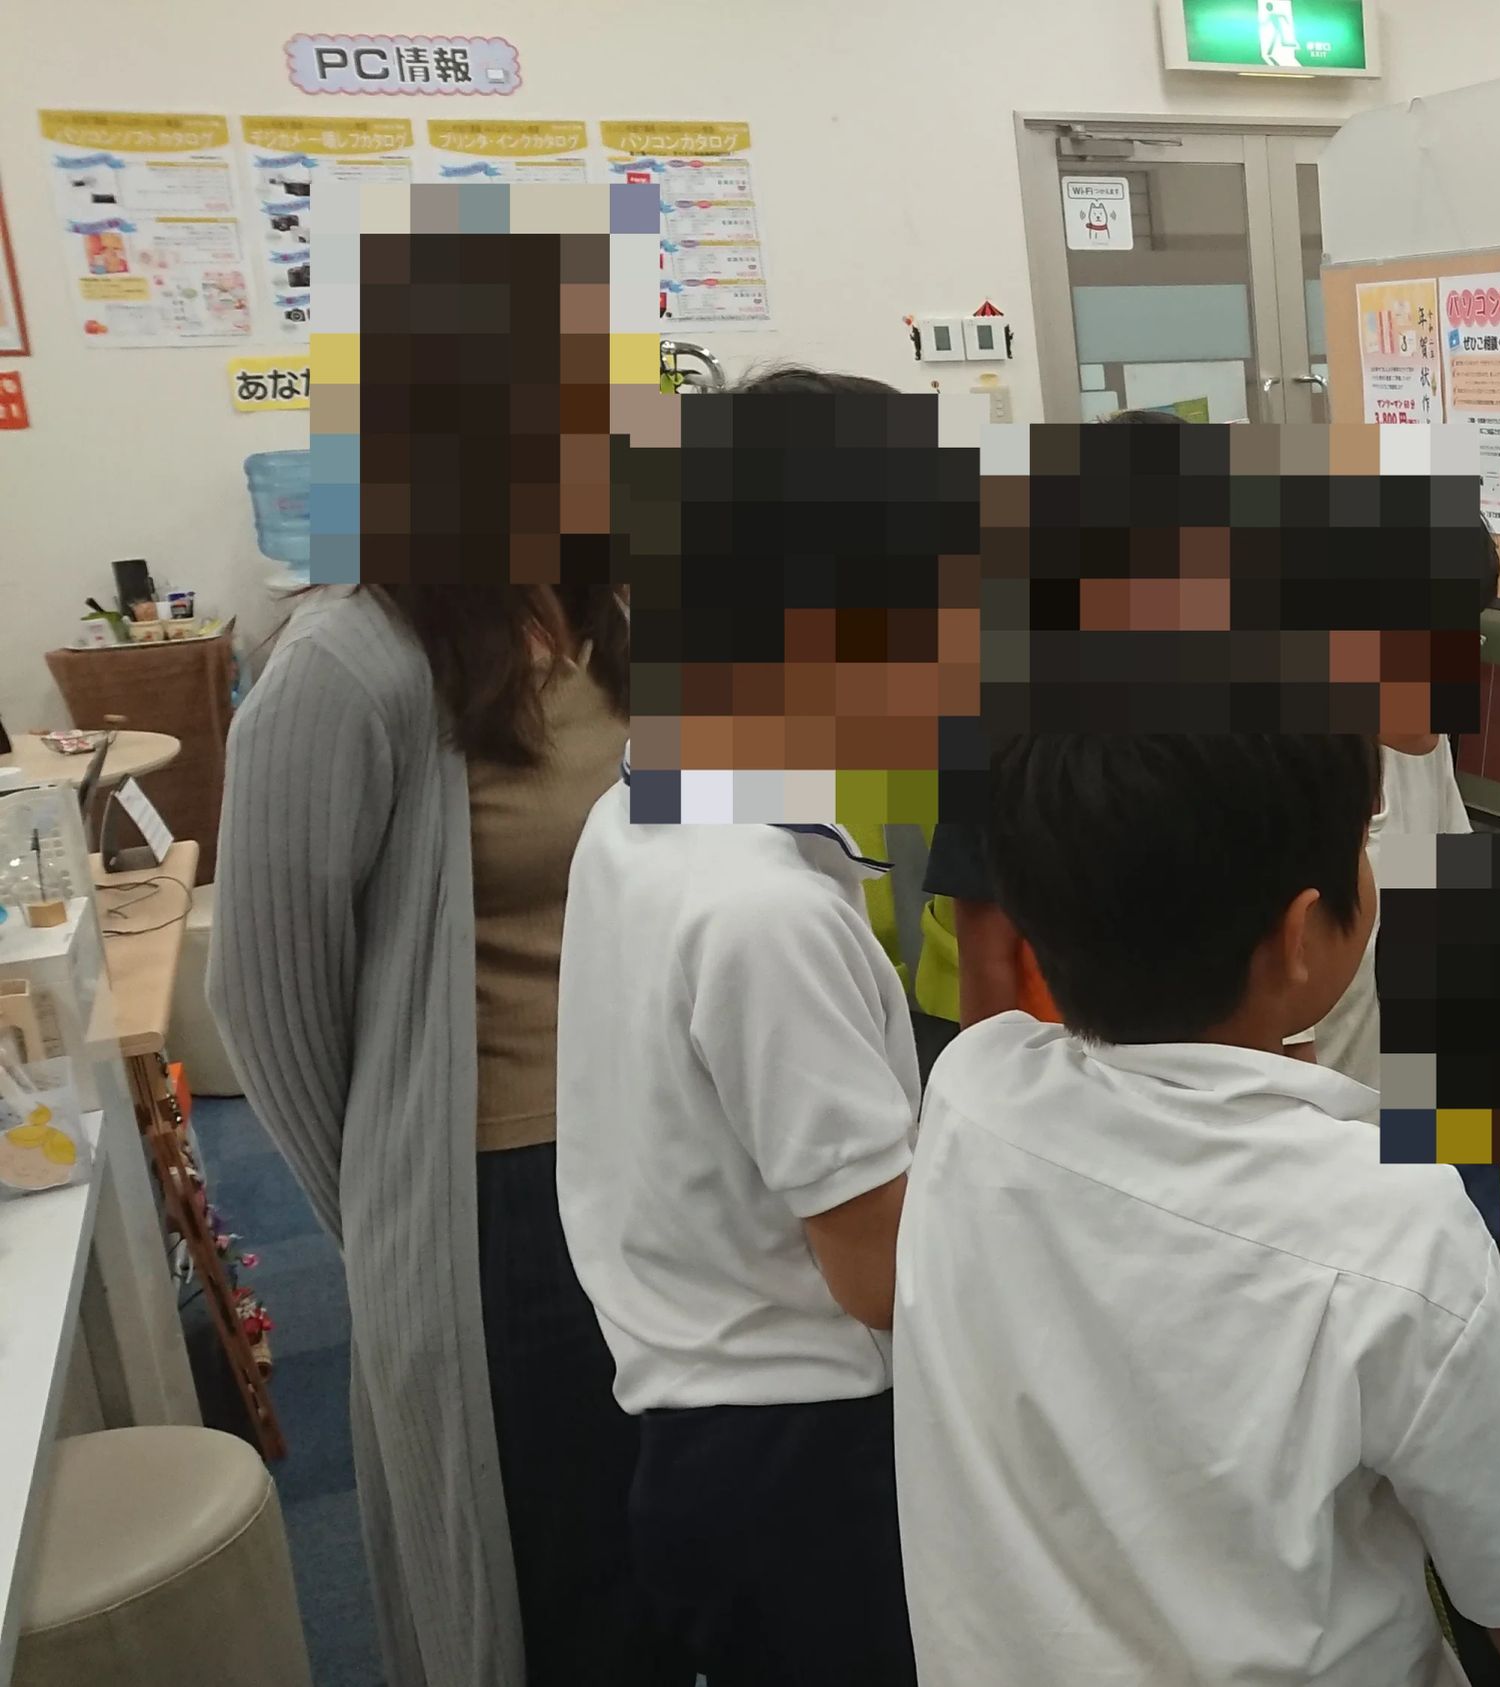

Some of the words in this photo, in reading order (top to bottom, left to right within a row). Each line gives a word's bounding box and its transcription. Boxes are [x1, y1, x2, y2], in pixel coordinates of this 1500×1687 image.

[314, 47, 473, 84] PC情報
[438, 133, 581, 150] プリンタ・インクカタログ
[619, 134, 738, 150] パソコンカタログ
[1417, 306, 1432, 424] 年賀状作
[236, 369, 310, 401] あな
